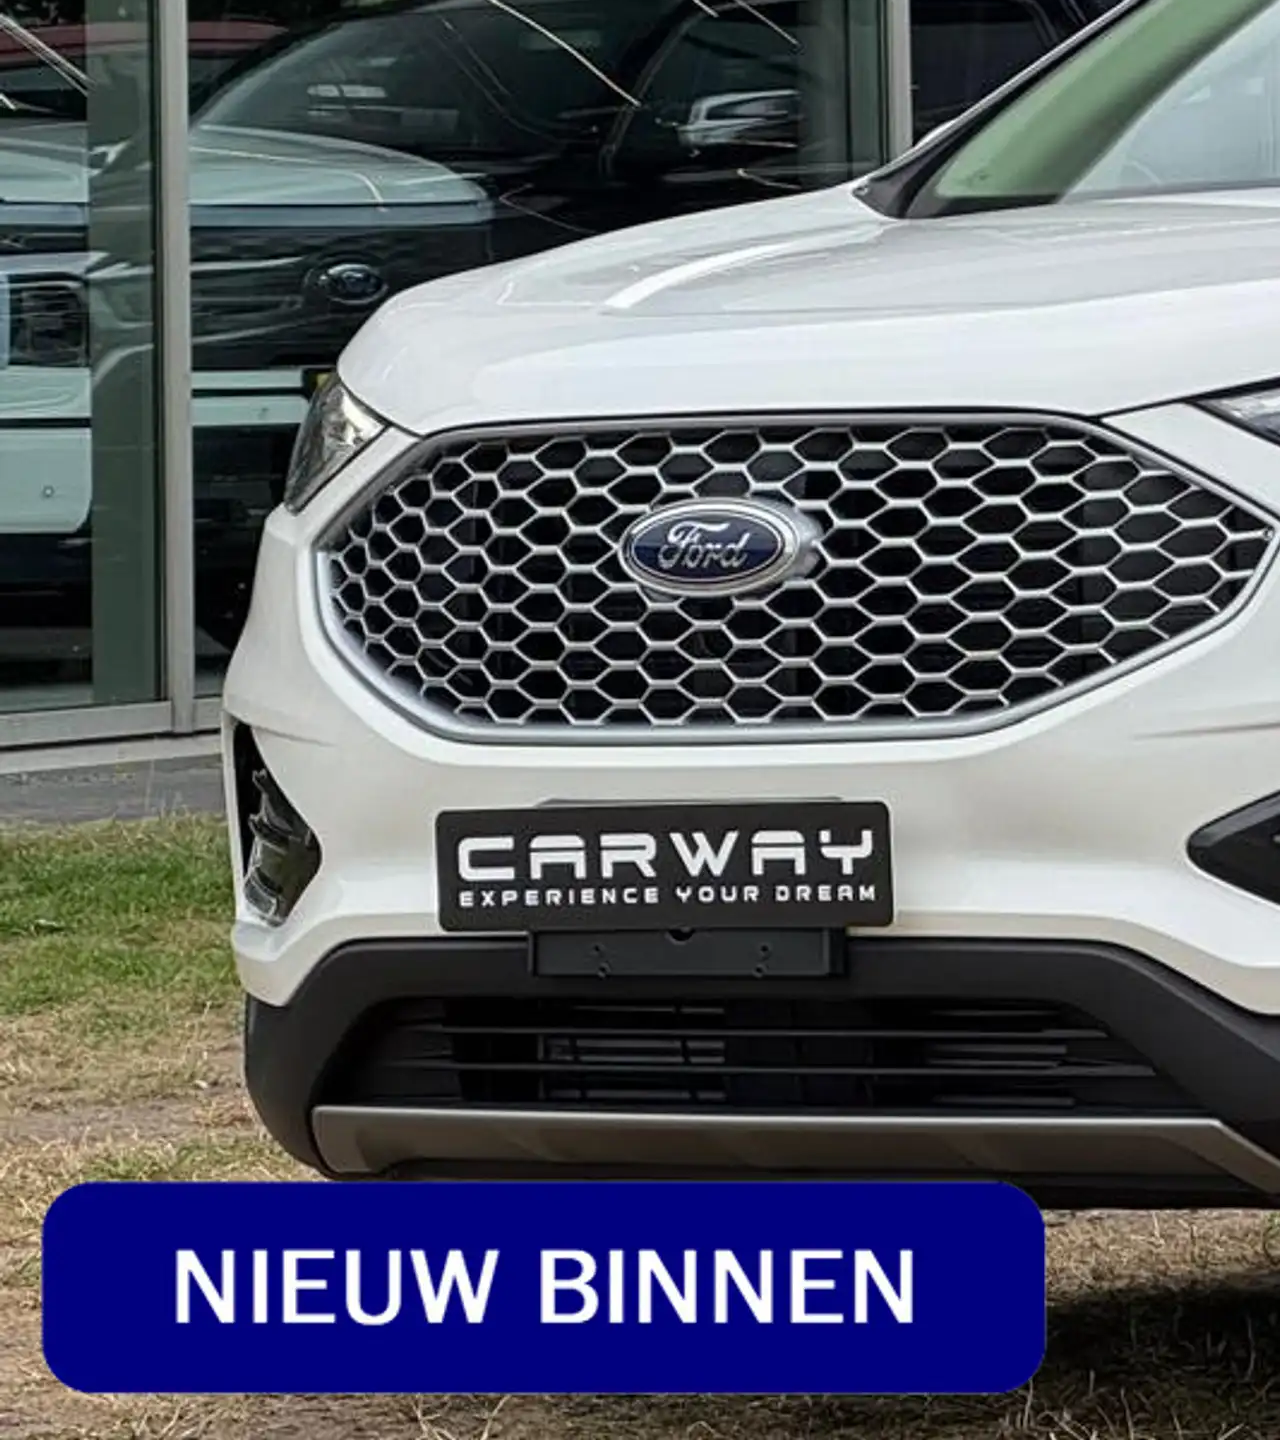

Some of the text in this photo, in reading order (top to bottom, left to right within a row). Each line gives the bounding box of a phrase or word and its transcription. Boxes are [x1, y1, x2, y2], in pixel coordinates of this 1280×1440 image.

[657, 520, 751, 570] Ford
[457, 829, 874, 881] CARWAY
[459, 885, 876, 908] EXPERIENCE YOUR DREAM
